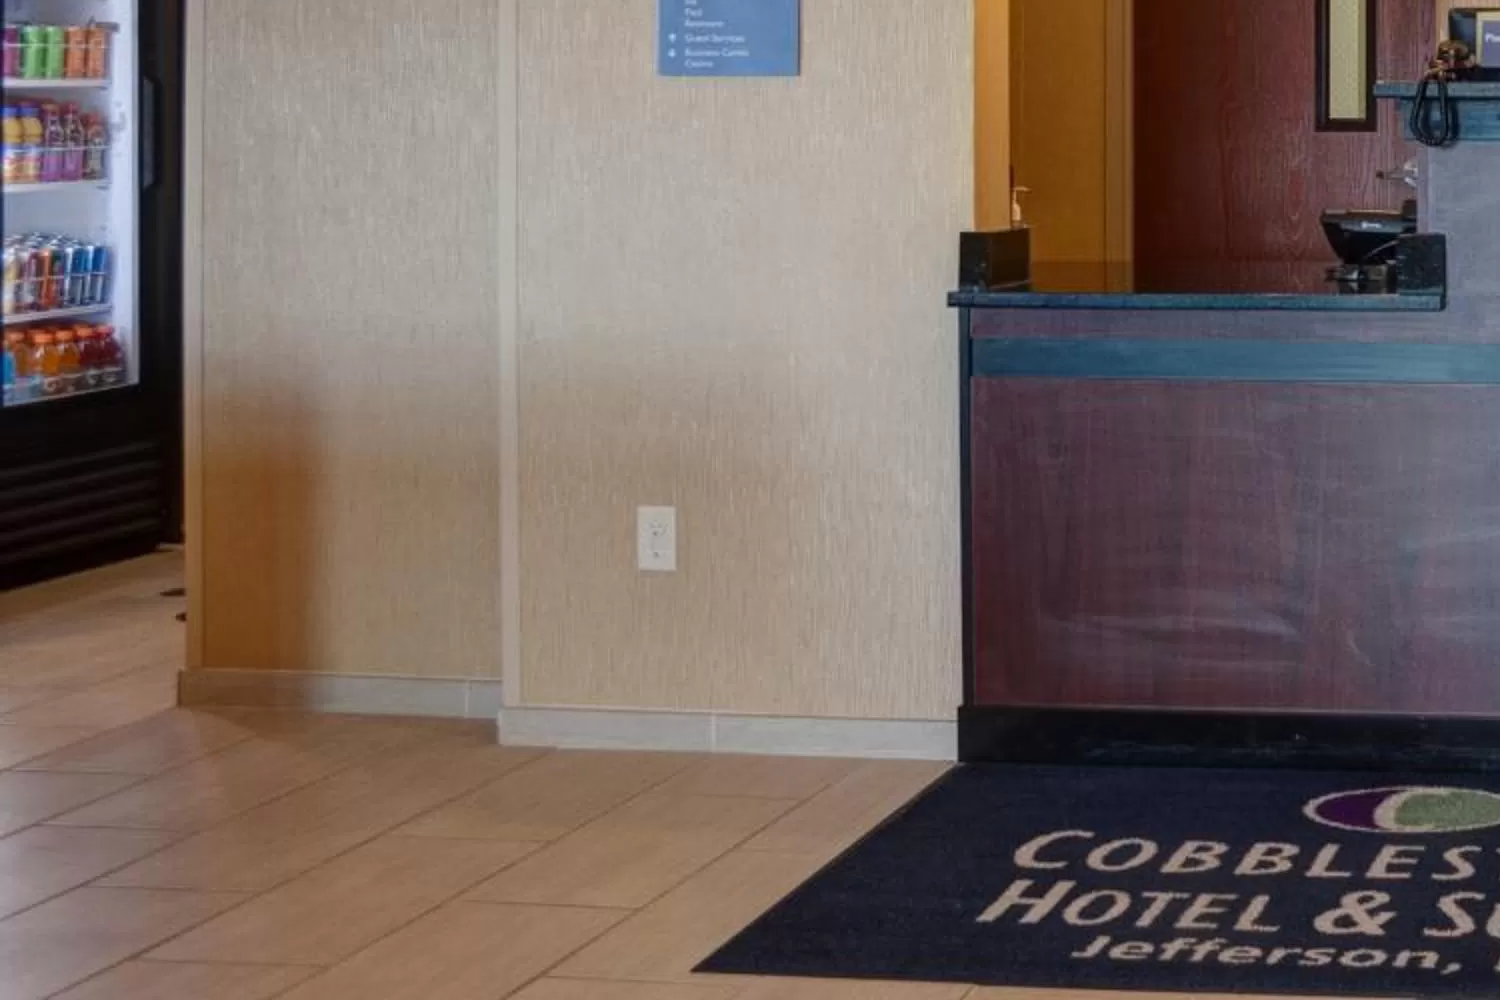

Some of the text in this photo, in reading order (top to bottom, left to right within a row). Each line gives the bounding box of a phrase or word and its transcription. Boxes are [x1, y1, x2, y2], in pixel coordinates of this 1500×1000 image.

[975, 879, 1281, 933] HOTEL
[1313, 889, 1396, 937] &
[1071, 935, 1462, 977] Jefferson,
